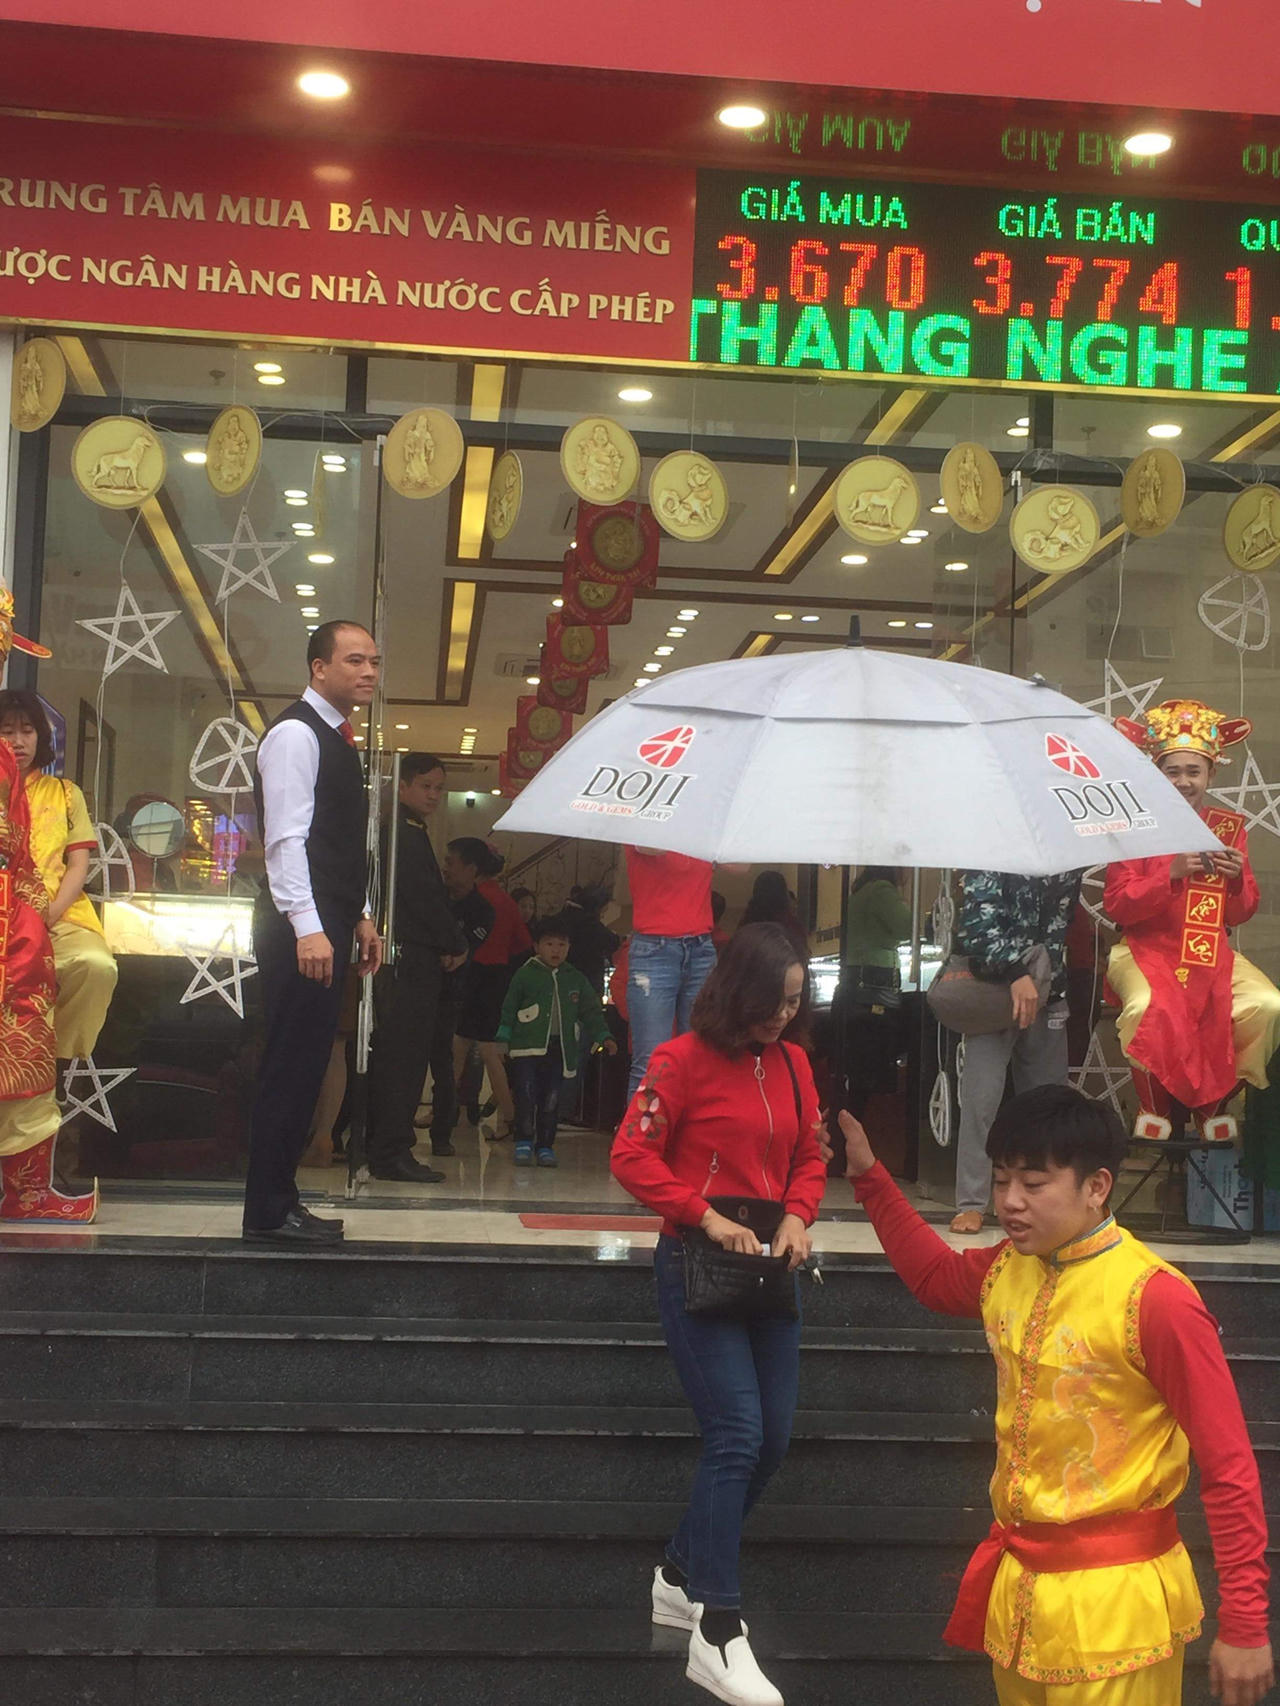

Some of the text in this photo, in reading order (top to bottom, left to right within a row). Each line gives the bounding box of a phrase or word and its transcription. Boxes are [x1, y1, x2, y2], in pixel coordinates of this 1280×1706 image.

[119, 183, 206, 221] TÂM
[216, 194, 311, 230] MUA
[329, 199, 411, 237] BÁN
[421, 204, 532, 246] VÀNG
[543, 209, 670, 255] MIẾNG
[740, 180, 908, 229] GIÁ MUA
[998, 198, 1155, 244] GIÁ BÁN
[81, 254, 188, 291] NGÂN
[198, 260, 301, 299] HÀNG
[310, 270, 387, 305] NHÀ
[396, 278, 502, 313] NƯỚC
[510, 277, 579, 318] CẤP
[588, 291, 675, 324] PHÉP
[716, 235, 926, 310] 3.670
[972, 251, 1179, 325] 3.774
[1006, 318, 1249, 392] NGHE
[581, 766, 692, 814] DOJI
[1053, 781, 1148, 828] DOJI
